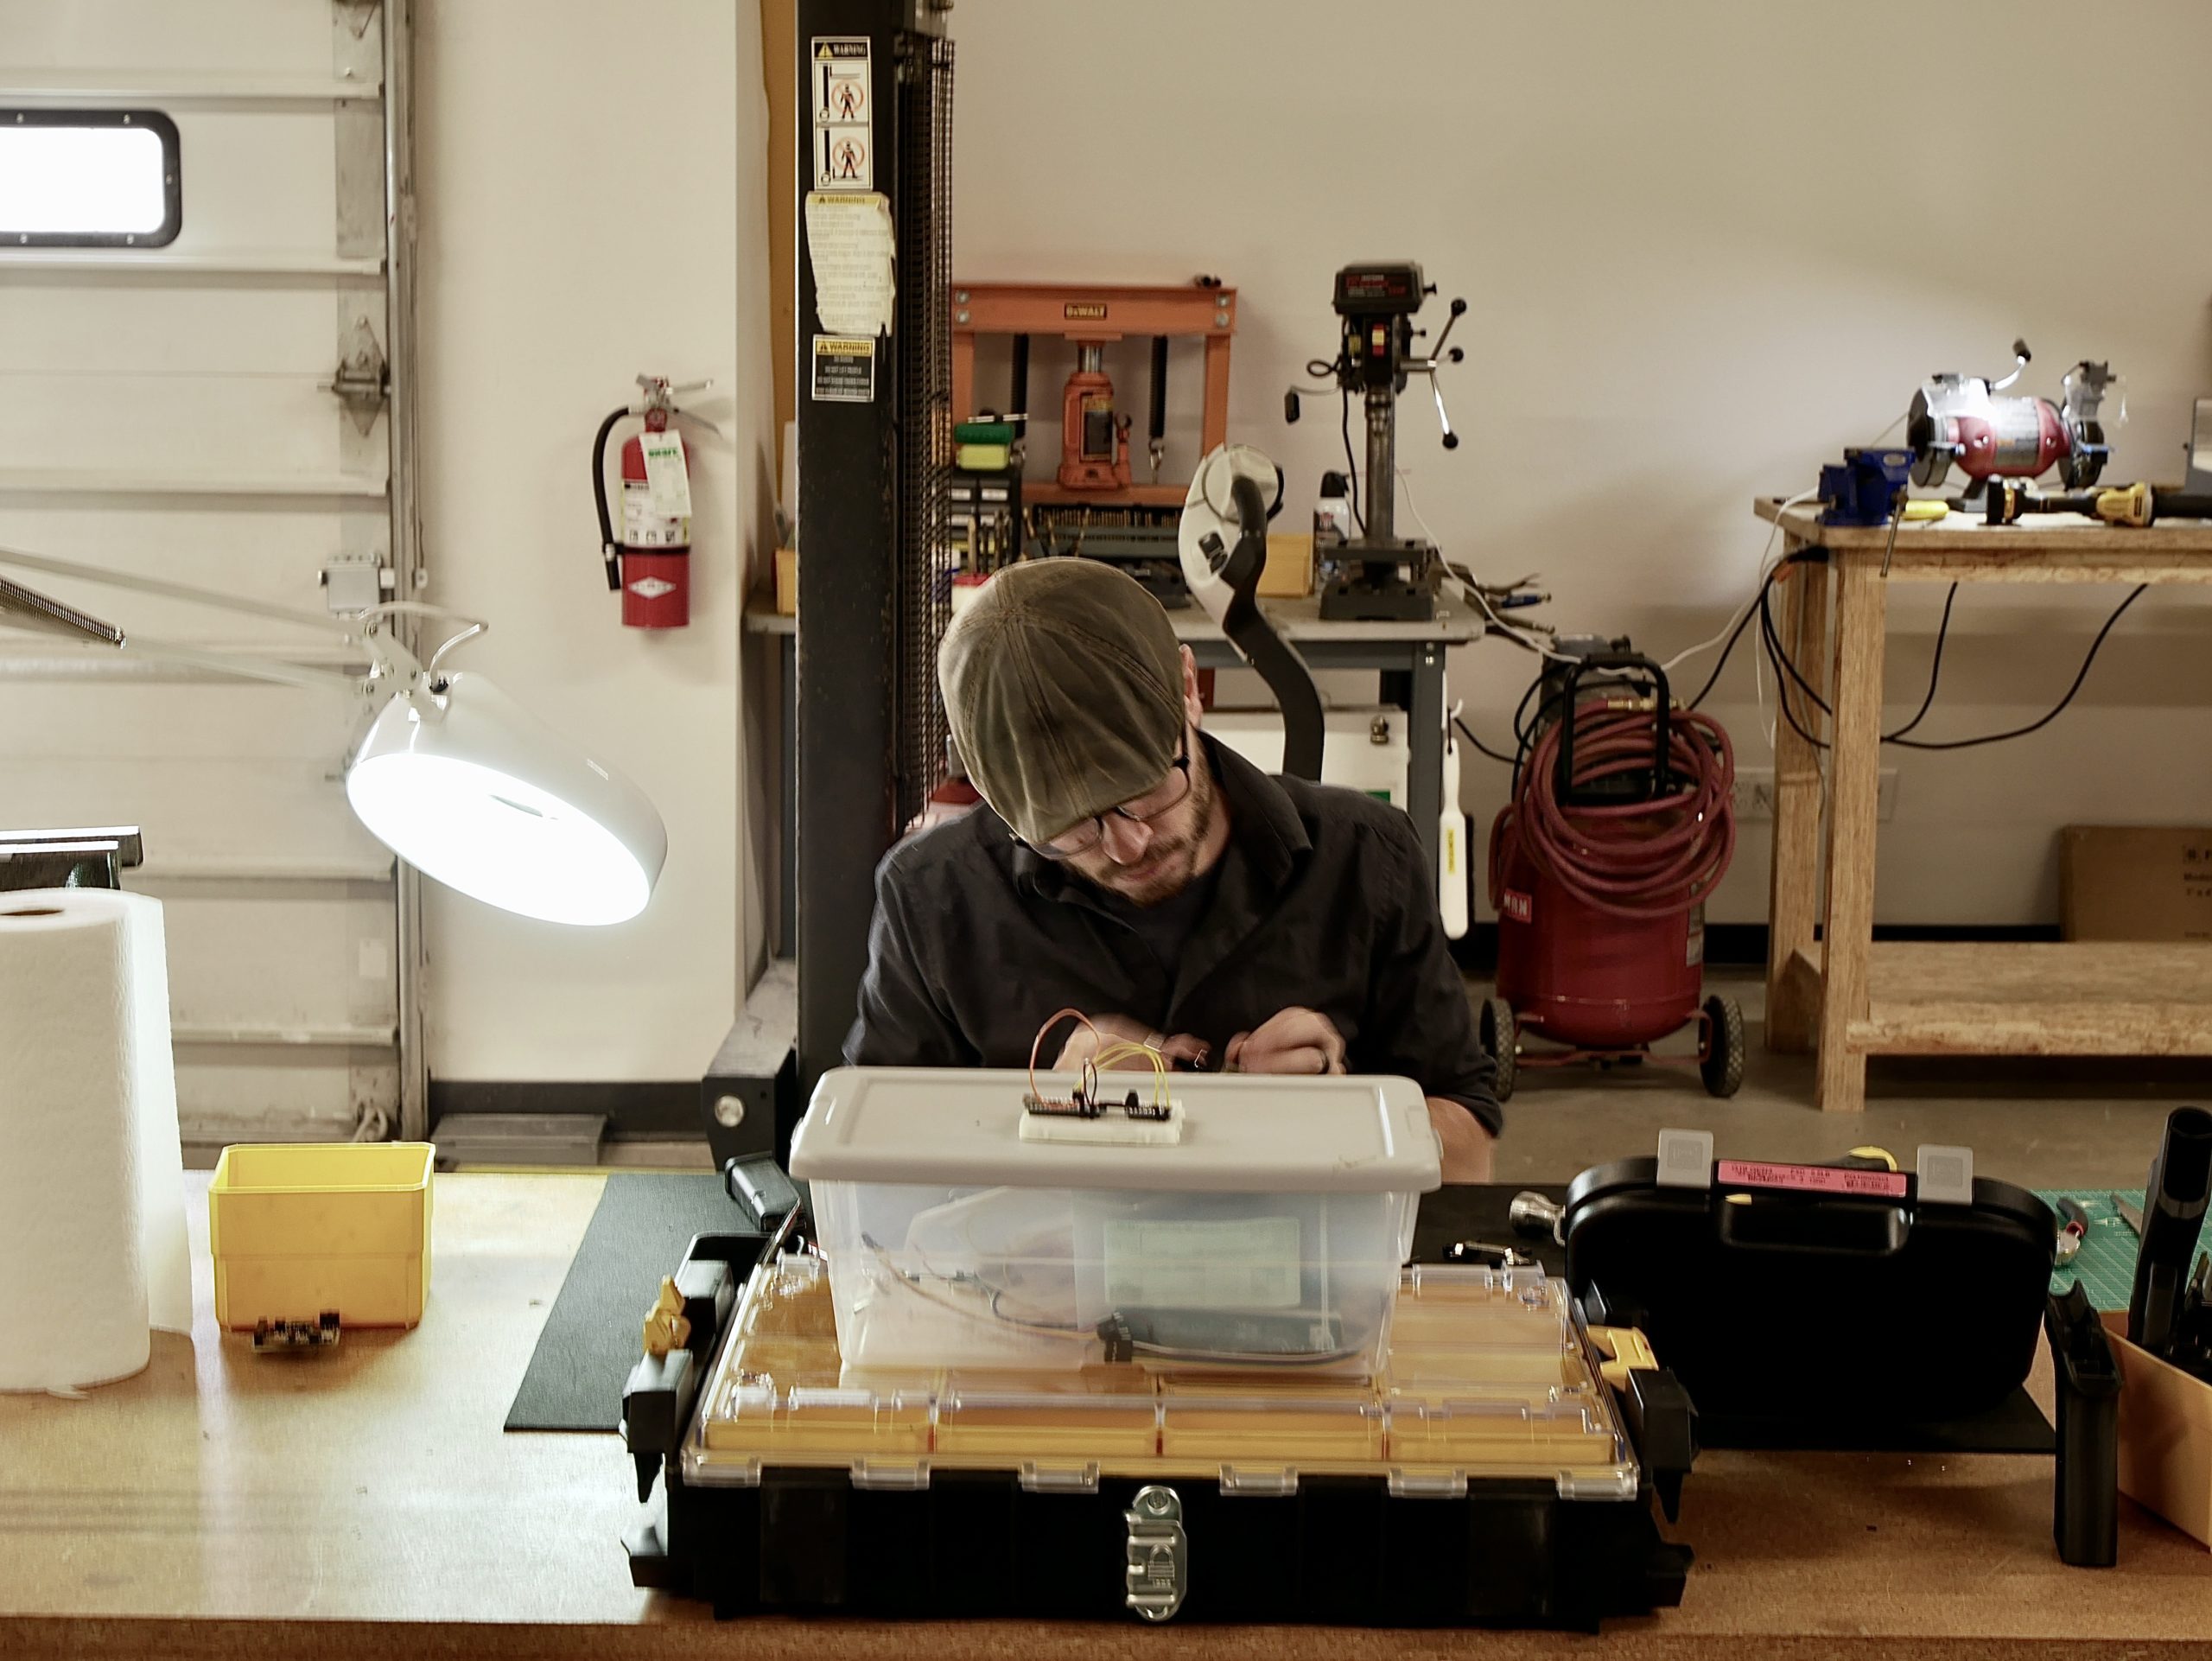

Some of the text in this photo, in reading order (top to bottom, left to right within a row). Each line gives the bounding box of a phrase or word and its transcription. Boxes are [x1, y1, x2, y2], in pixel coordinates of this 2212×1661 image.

[833, 43, 866, 56] WARNING
[827, 196, 865, 205] WARNING
[830, 342, 869, 353] WARNING
